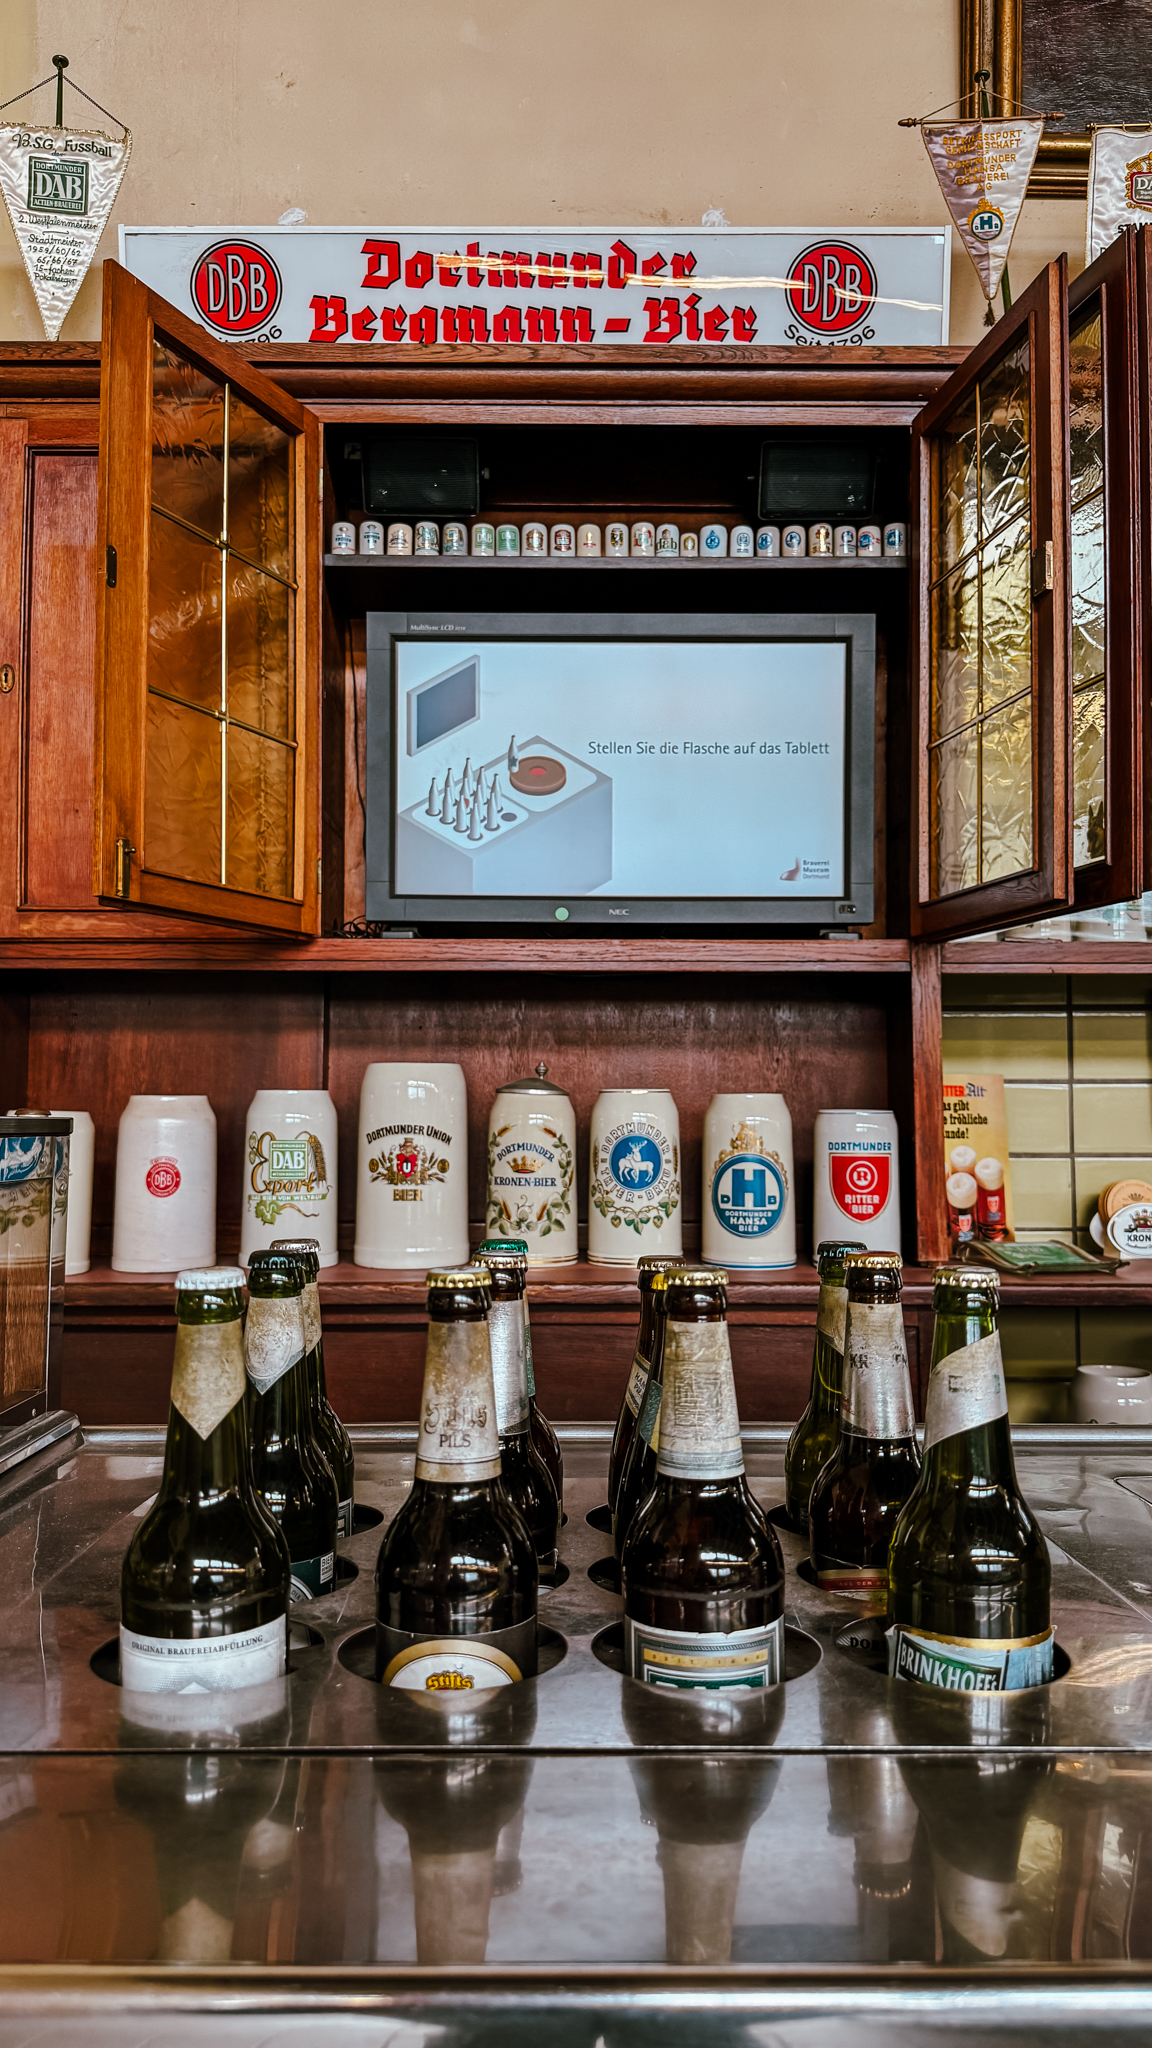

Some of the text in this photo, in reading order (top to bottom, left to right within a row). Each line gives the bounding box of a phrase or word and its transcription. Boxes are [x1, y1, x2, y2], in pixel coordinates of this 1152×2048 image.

[64, 140, 112, 157] Fussball
[35, 162, 82, 174] DORTMUNDER
[947, 154, 1016, 169] DORTMUNDER
[964, 164, 1004, 175] HANSA
[34, 172, 82, 200] DAB
[957, 172, 1009, 185] BRAUEREI
[28, 214, 97, 230] Westfalenmeister
[28, 234, 84, 247] Stadtmeister
[28, 245, 82, 257] 1959/60/62
[361, 239, 697, 290] Dortmunder
[206, 253, 269, 322] DBB
[801, 254, 862, 323] DBB
[588, 741, 830, 755] Stellen Sie die Flasche auf das Tablett
[966, 1083, 987, 1097] Alt
[953, 1100, 970, 1113] gibt
[366, 1124, 453, 1146] DORTMUNDER UNION
[601, 1122, 670, 1155] DORTMUNDER
[944, 1128, 969, 1139] unde!
[497, 1142, 555, 1162] DORTMUNDER
[828, 1142, 891, 1151] DORTMUNDER
[251, 1131, 318, 1196] Export
[272, 1150, 305, 1169] DAB
[154, 1171, 172, 1188] DBB
[393, 1189, 423, 1201] BIER
[844, 1194, 880, 1204] RITTER
[852, 1204, 874, 1214] BIER
[730, 1216, 767, 1225] HANSA
[439, 1433, 471, 1448] PILS
[131, 1635, 263, 1655] ORIGINAL BRAUEREIABFÜLLUNG
[427, 1671, 474, 1690] Stifts
